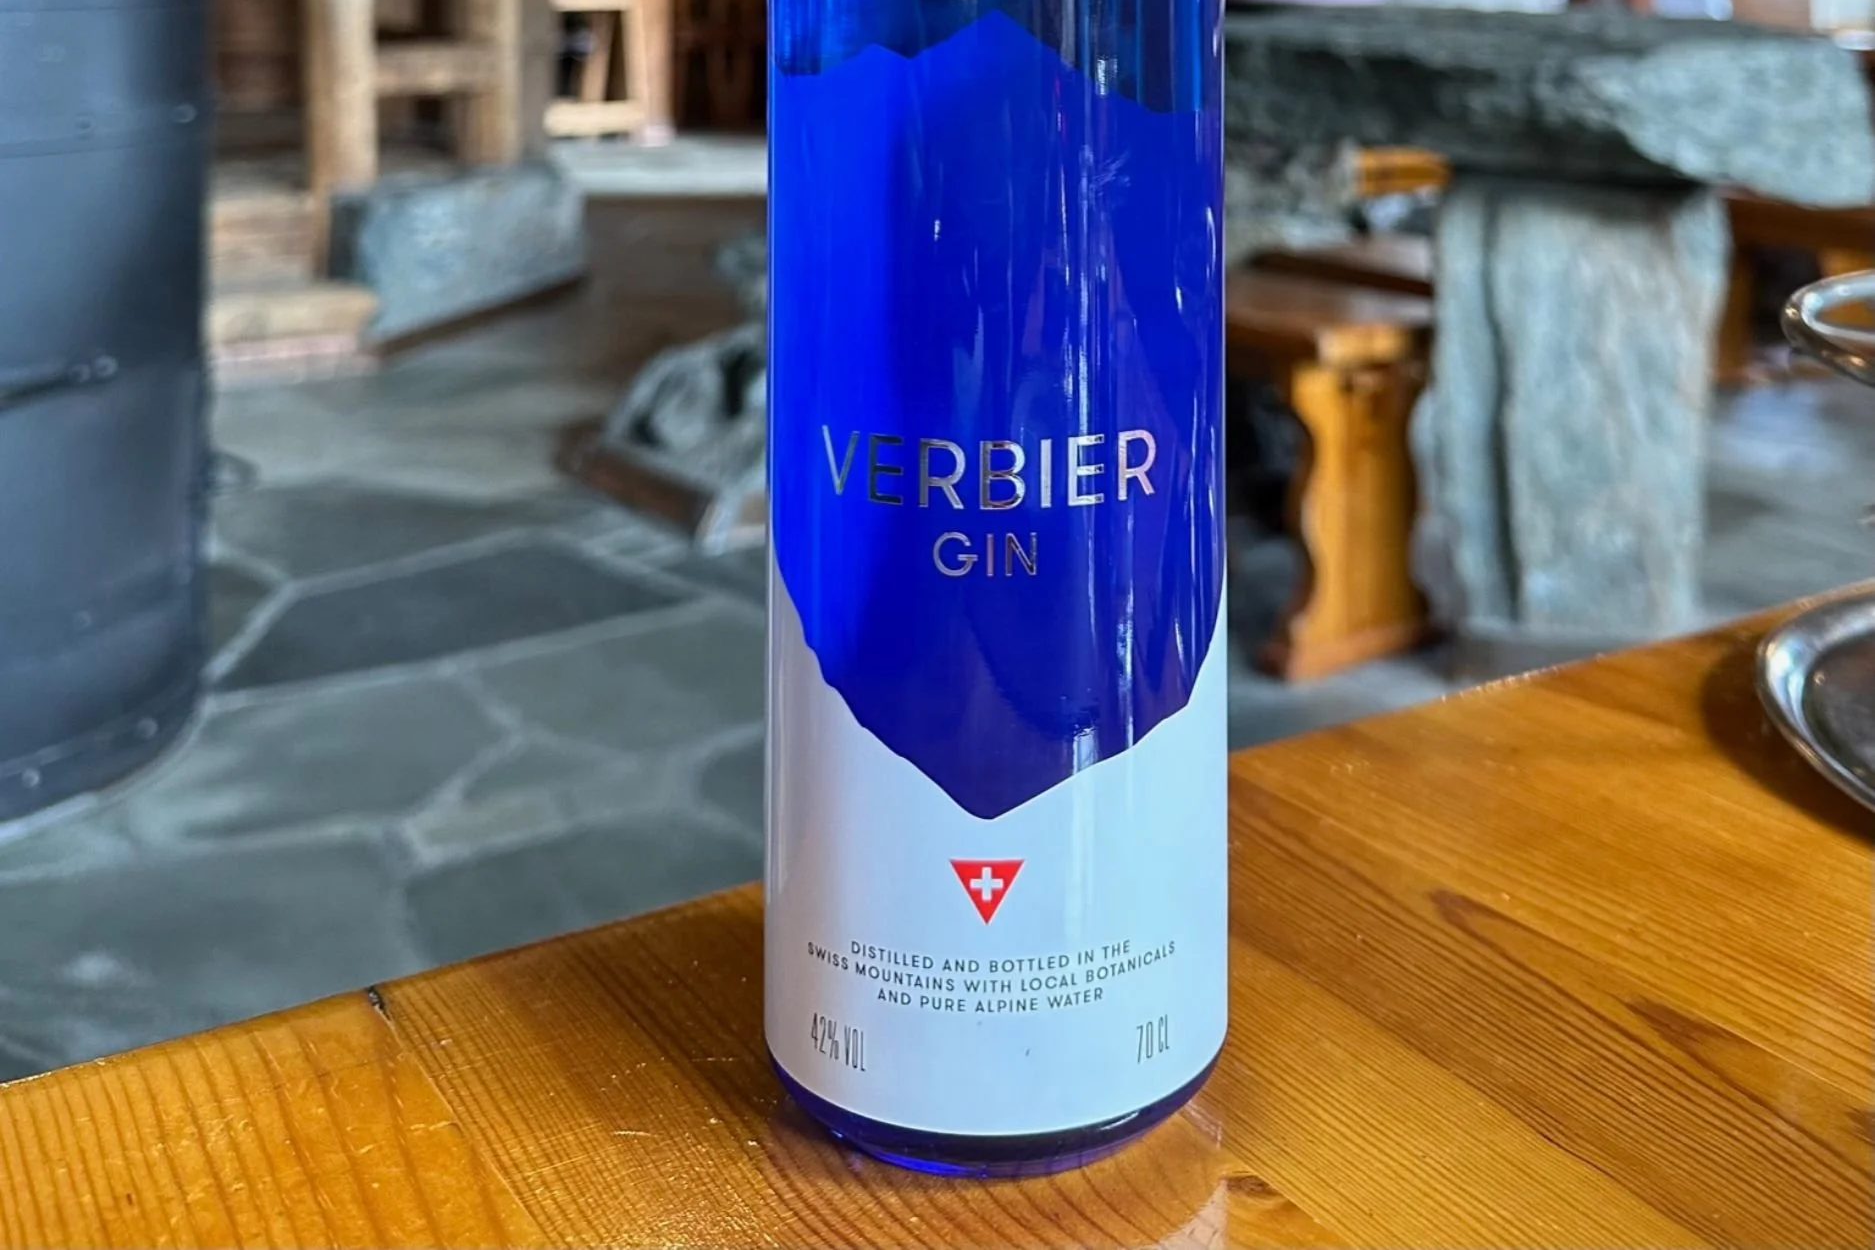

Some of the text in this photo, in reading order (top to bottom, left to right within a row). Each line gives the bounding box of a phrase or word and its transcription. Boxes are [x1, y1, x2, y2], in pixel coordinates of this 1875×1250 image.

[822, 425, 1157, 510] VERBIER
[932, 532, 1037, 577] GIN
[807, 940, 1176, 993] SWISS MOUNTAINS WITH LOCAL BOTANICALS
[851, 939, 1131, 973] DISTILLED AND BOTTLED IN THE
[877, 987, 1104, 1012] AND PURE ALPINE WATER
[811, 1012, 866, 1072] 42% VOL
[1136, 1014, 1170, 1064] 70 CL
